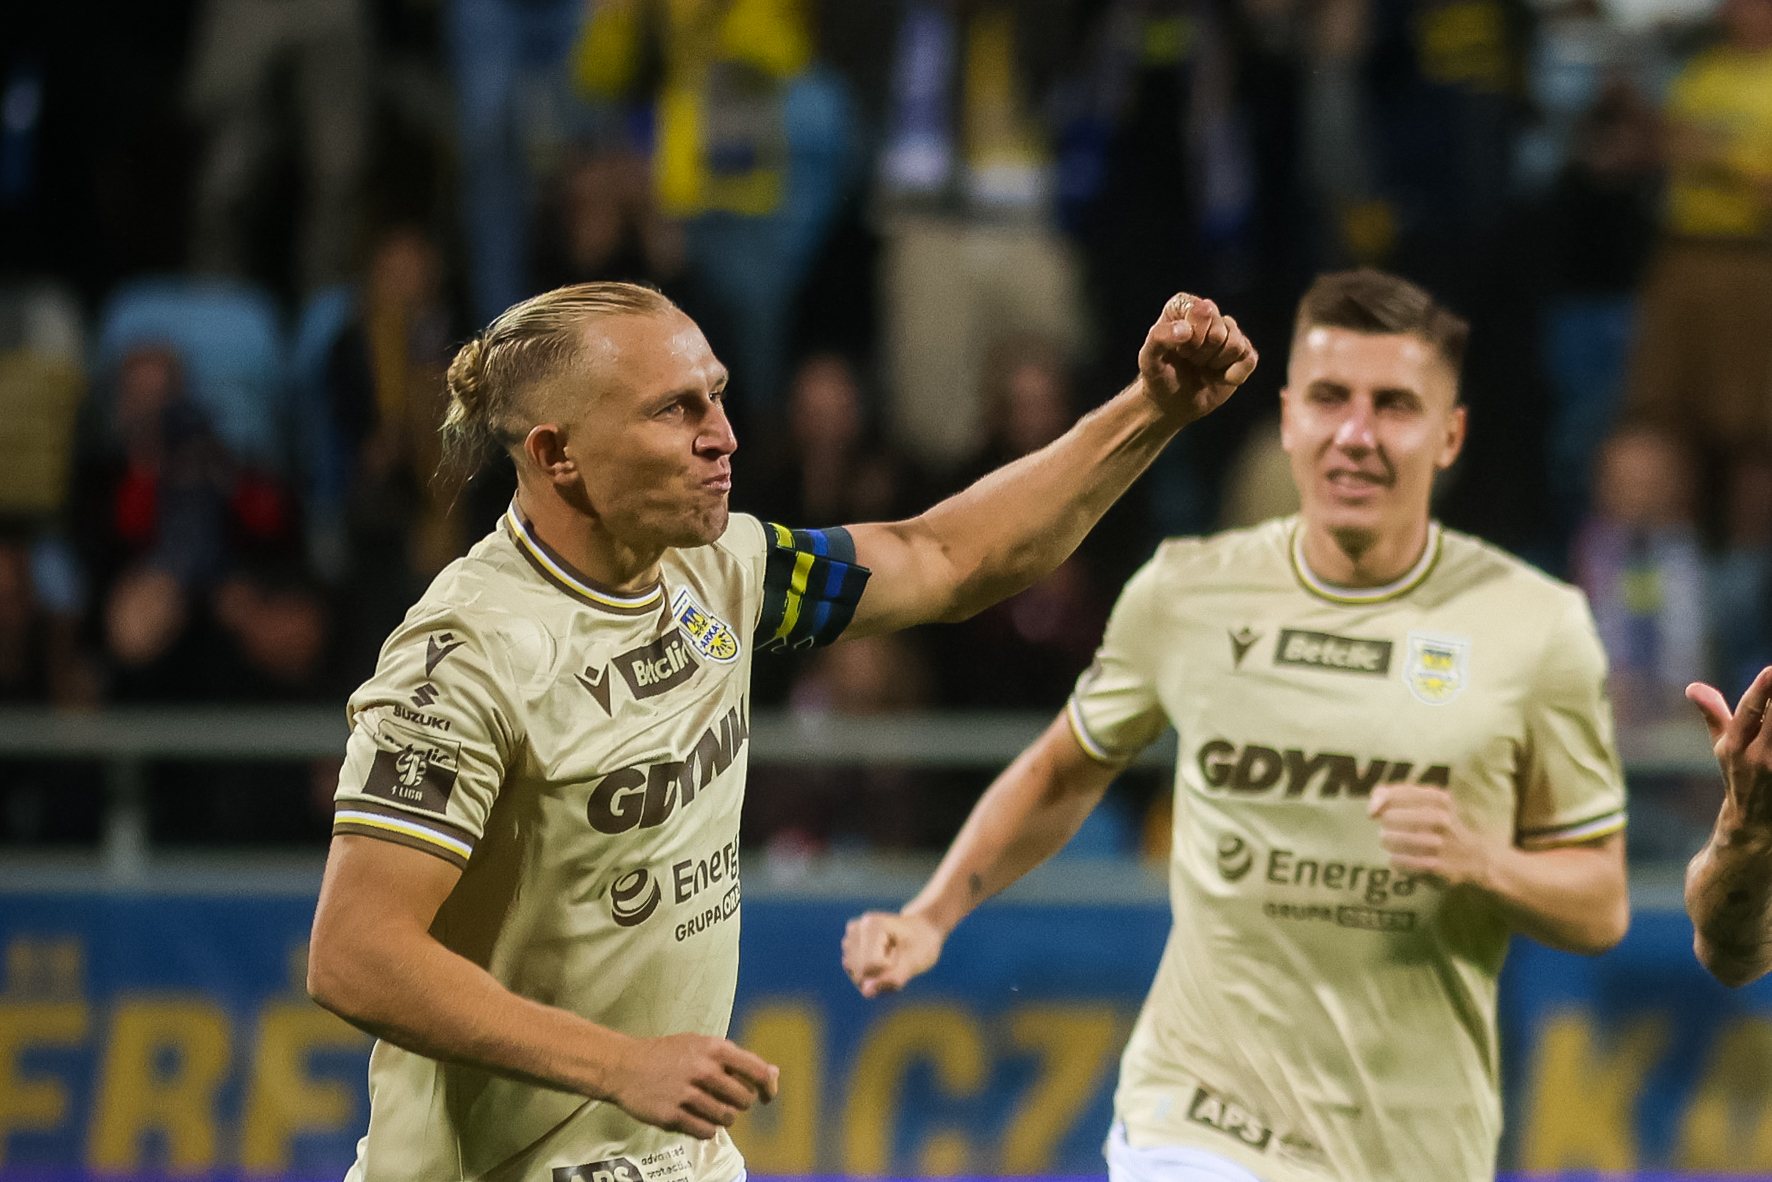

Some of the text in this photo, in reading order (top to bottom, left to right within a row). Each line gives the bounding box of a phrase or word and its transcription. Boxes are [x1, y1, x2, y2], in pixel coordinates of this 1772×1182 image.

[700, 624, 720, 649] ARKA
[631, 640, 689, 687] Btcli
[393, 704, 451, 732] SUZUKI
[587, 692, 749, 834] GDYNI
[1267, 849, 1414, 905] Energa
[675, 904, 722, 942] GRUPA
[1196, 1098, 1263, 1143] APS
